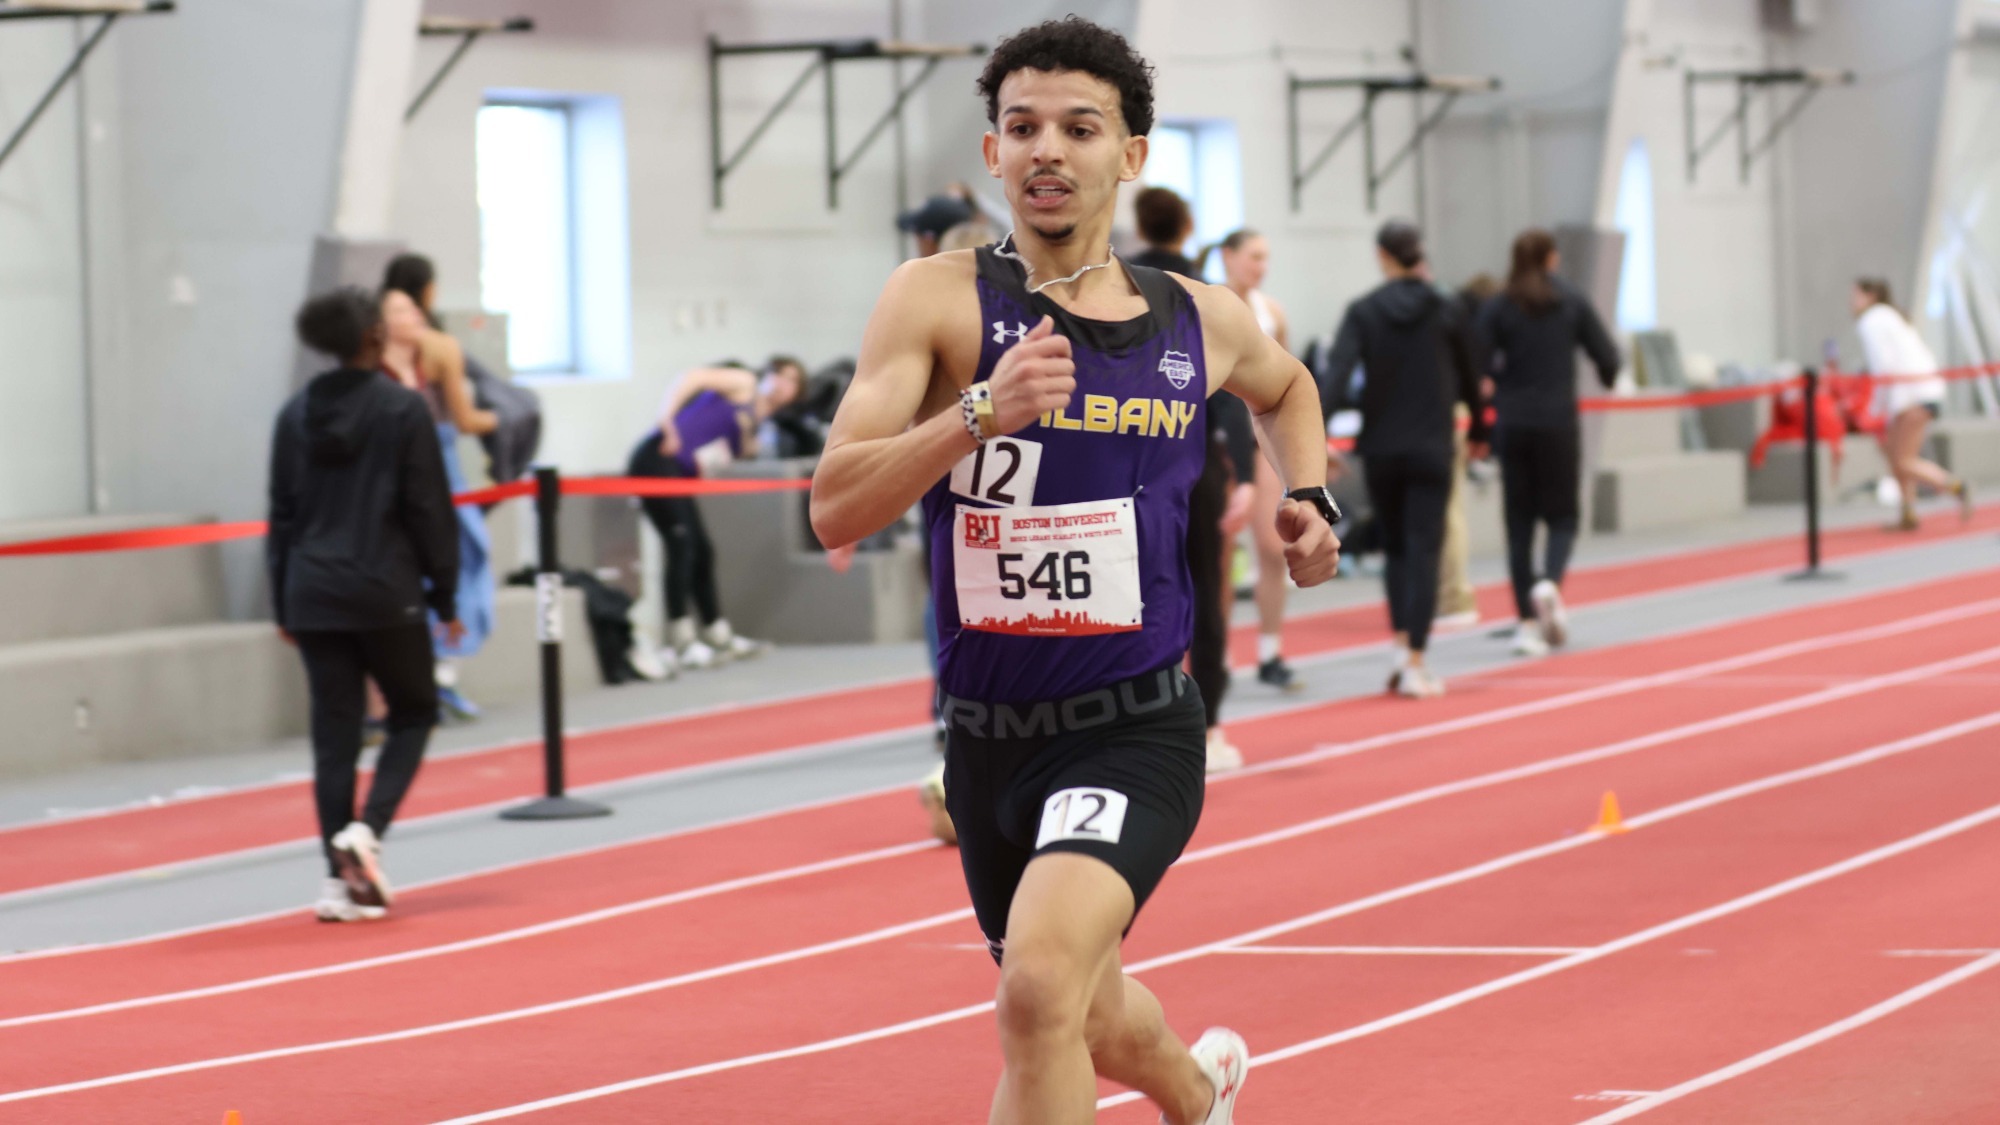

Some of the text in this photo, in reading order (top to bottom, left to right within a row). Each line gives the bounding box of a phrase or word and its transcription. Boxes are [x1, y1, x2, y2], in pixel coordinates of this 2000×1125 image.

[1040, 394, 1197, 439] LBANY
[969, 442, 1021, 505] 12
[965, 513, 1000, 543] BU
[1012, 511, 1116, 529] BOSTON UNIVERSITY
[997, 551, 1091, 600] 546
[1053, 793, 1108, 837] 12
